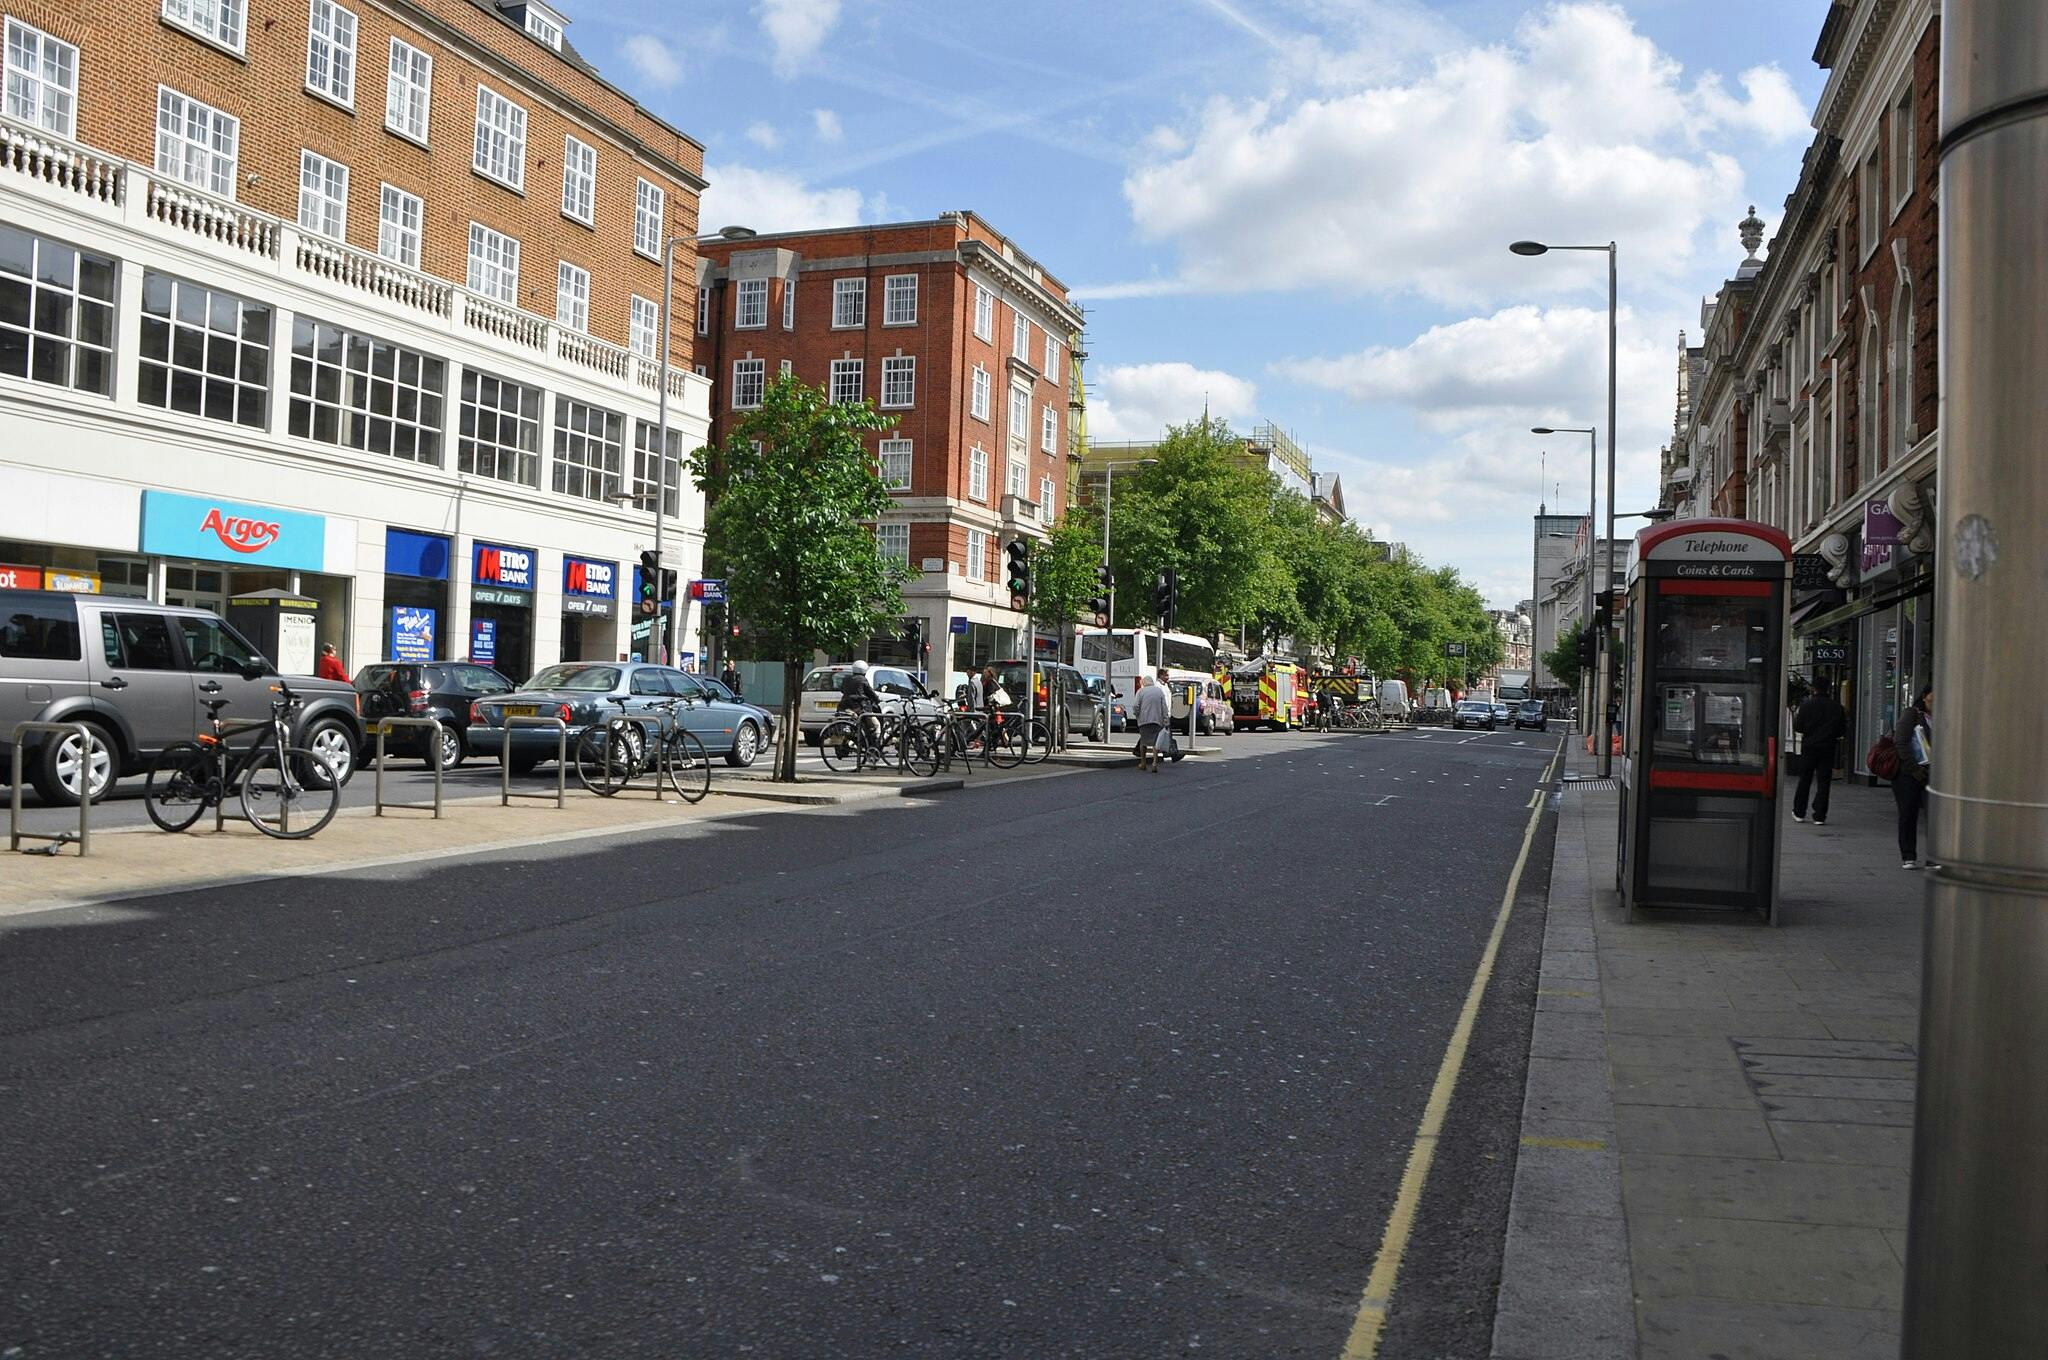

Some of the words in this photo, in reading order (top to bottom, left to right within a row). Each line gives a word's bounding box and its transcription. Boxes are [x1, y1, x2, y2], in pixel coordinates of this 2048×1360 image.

[1871, 503, 1891, 515] GA
[200, 508, 281, 553] Argos
[1685, 540, 1749, 554] Telephone
[480, 547, 529, 581] METRO
[1792, 556, 1825, 566] IZZA
[568, 560, 612, 592] METRO
[1677, 565, 1707, 576] Coins
[1709, 565, 1720, 576] &
[1722, 564, 1754, 576] Cards
[1794, 566, 1825, 576] ASTA
[500, 570, 529, 585] BANK
[585, 581, 611, 595] BANK
[475, 591, 496, 601] OPEN
[496, 591, 504, 603] 7
[503, 594, 521, 604] DAYS
[567, 601, 586, 611] OPEN
[585, 600, 593, 611] 7
[592, 604, 608, 614] DAYS
[1816, 648, 1845, 659] £6.50
